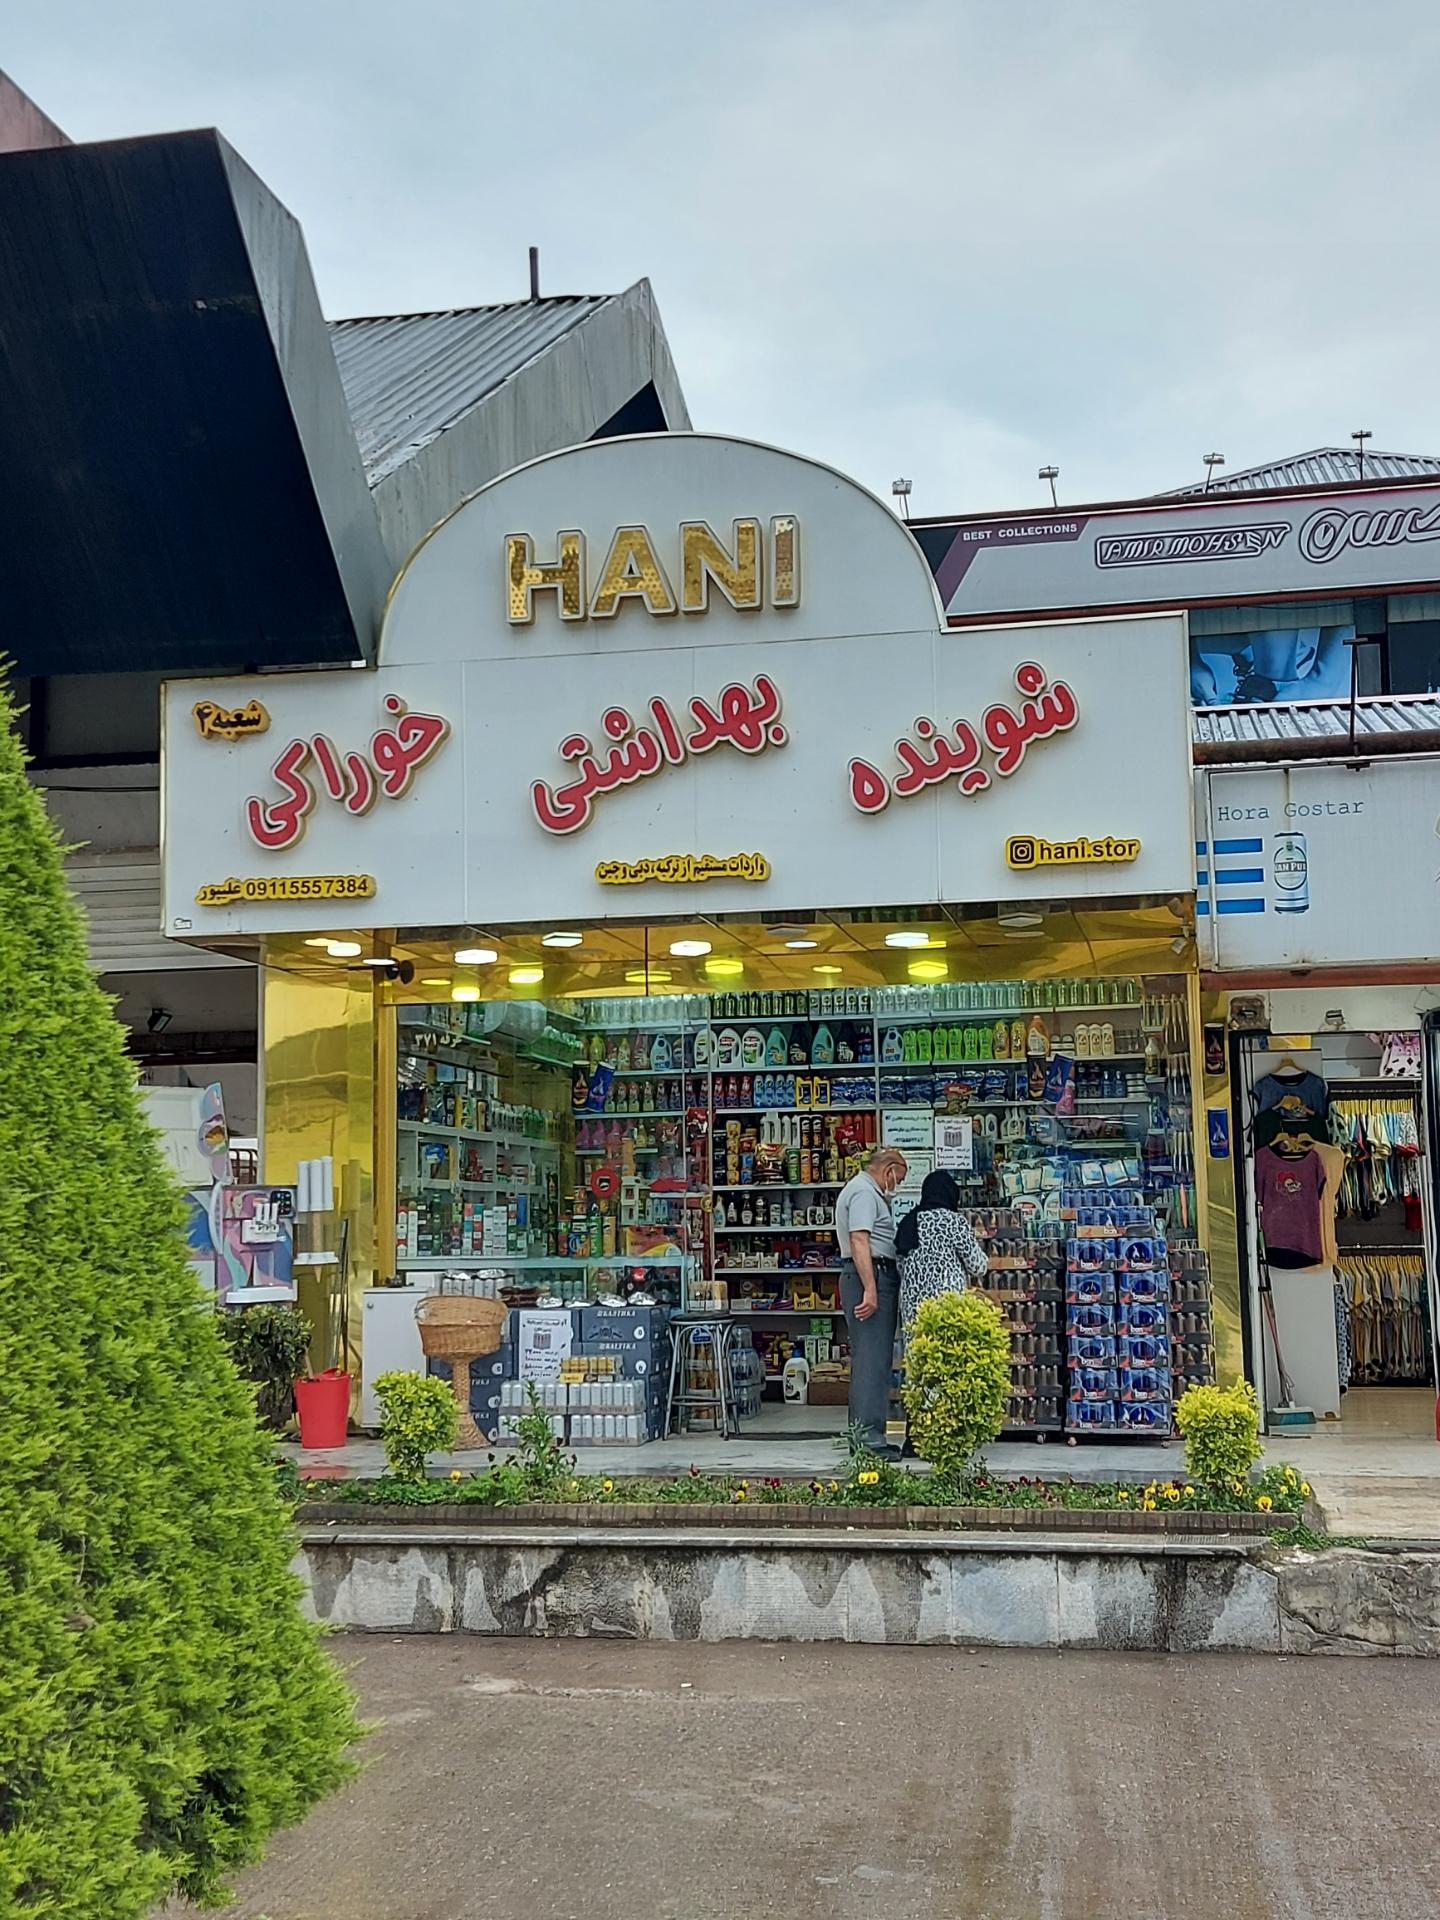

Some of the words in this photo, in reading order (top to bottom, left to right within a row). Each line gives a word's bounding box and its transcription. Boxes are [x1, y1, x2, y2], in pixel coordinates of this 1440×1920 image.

[963, 530, 992, 541] BEST
[998, 523, 1078, 538] COLLECTIONS
[1103, 538, 1164, 561] AMIR
[504, 514, 799, 625] HANI
[848, 661, 1078, 813] شوینده
[531, 673, 789, 836] بهداشتی
[246, 693, 448, 850] خوراکی
[1217, 806, 1270, 821] Hora
[1283, 801, 1364, 818] Gostar
[1039, 841, 1137, 861] hani.stor
[693, 858, 728, 877] مستقیم
[728, 856, 765, 877] واردات
[246, 879, 368, 897] 09115557384
